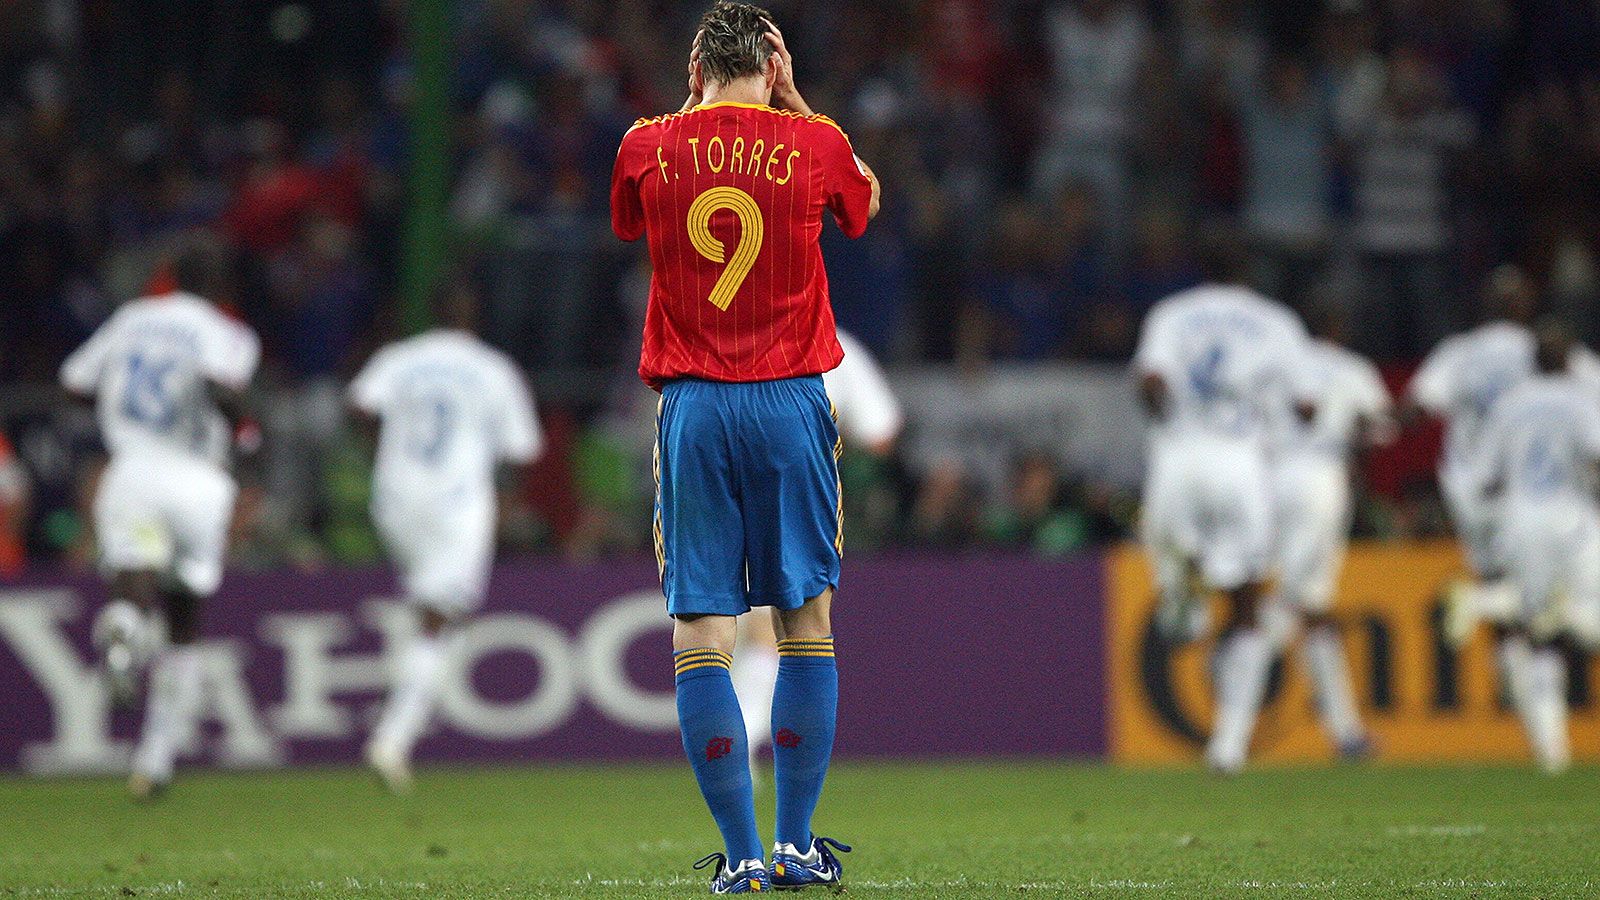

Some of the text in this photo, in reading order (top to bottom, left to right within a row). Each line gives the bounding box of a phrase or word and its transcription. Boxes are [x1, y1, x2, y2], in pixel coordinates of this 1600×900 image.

[656, 136, 801, 186] F. TORRES
[686, 186, 764, 312] 9
